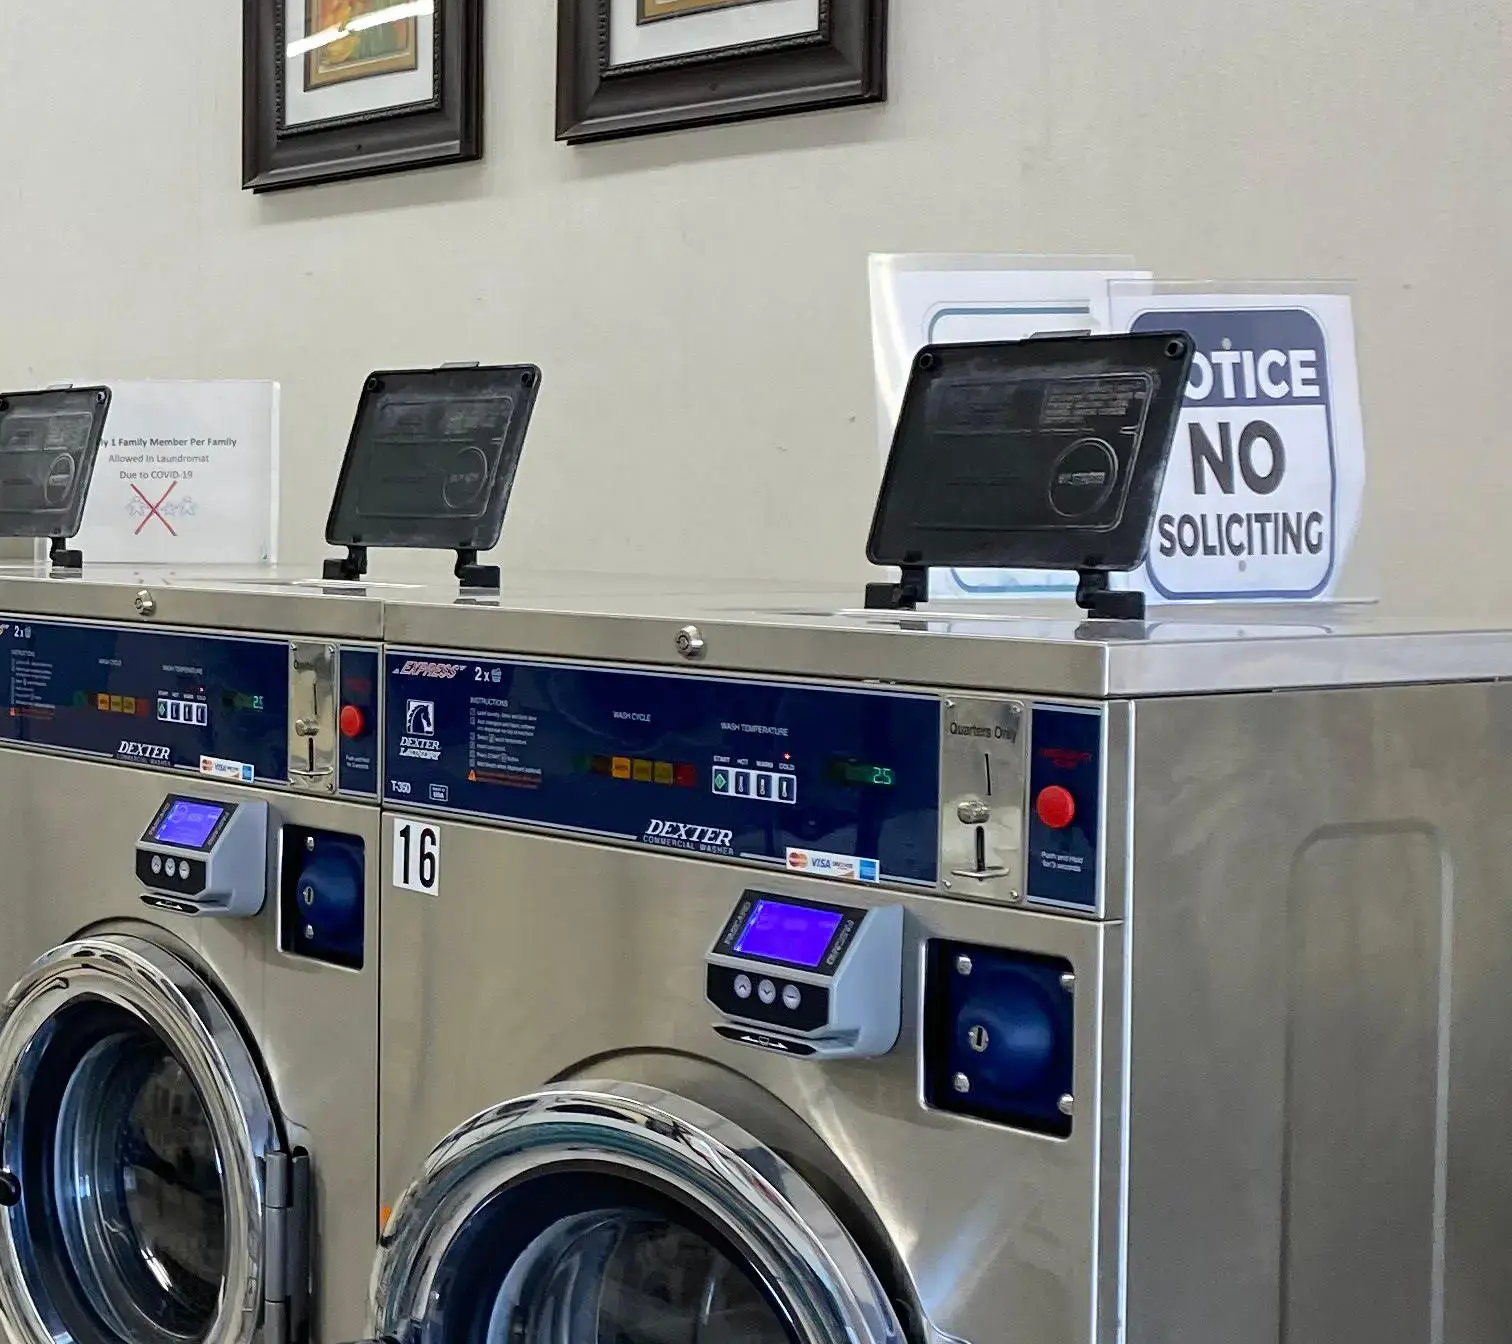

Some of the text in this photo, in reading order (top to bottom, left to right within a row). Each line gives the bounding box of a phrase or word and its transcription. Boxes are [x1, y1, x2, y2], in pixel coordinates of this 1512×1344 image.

[111, 438, 116, 447] 1
[118, 438, 148, 448] Family
[149, 438, 186, 447] Member
[190, 438, 205, 447] Per
[207, 438, 237, 448] Family
[108, 454, 144, 463] Allowed
[157, 454, 210, 463] Laundromat
[1188, 419, 1287, 496] NO
[119, 471, 193, 479] Due to COVID-19
[1158, 509, 1325, 558] SOLICITING
[399, 660, 461, 679] EXPRESS
[613, 711, 651, 723] WASH CYCLE
[720, 721, 789, 737] WASH TEMPERATURE
[994, 726, 1018, 743] Only
[118, 740, 171, 760] DEXTER
[400, 736, 441, 750] DEXTER
[872, 766, 892, 785] 25
[644, 819, 733, 846] DEXTER
[643, 835, 734, 856] COMMERCIAL WASHER
[397, 823, 437, 891] 16
[811, 858, 831, 869] VISA
